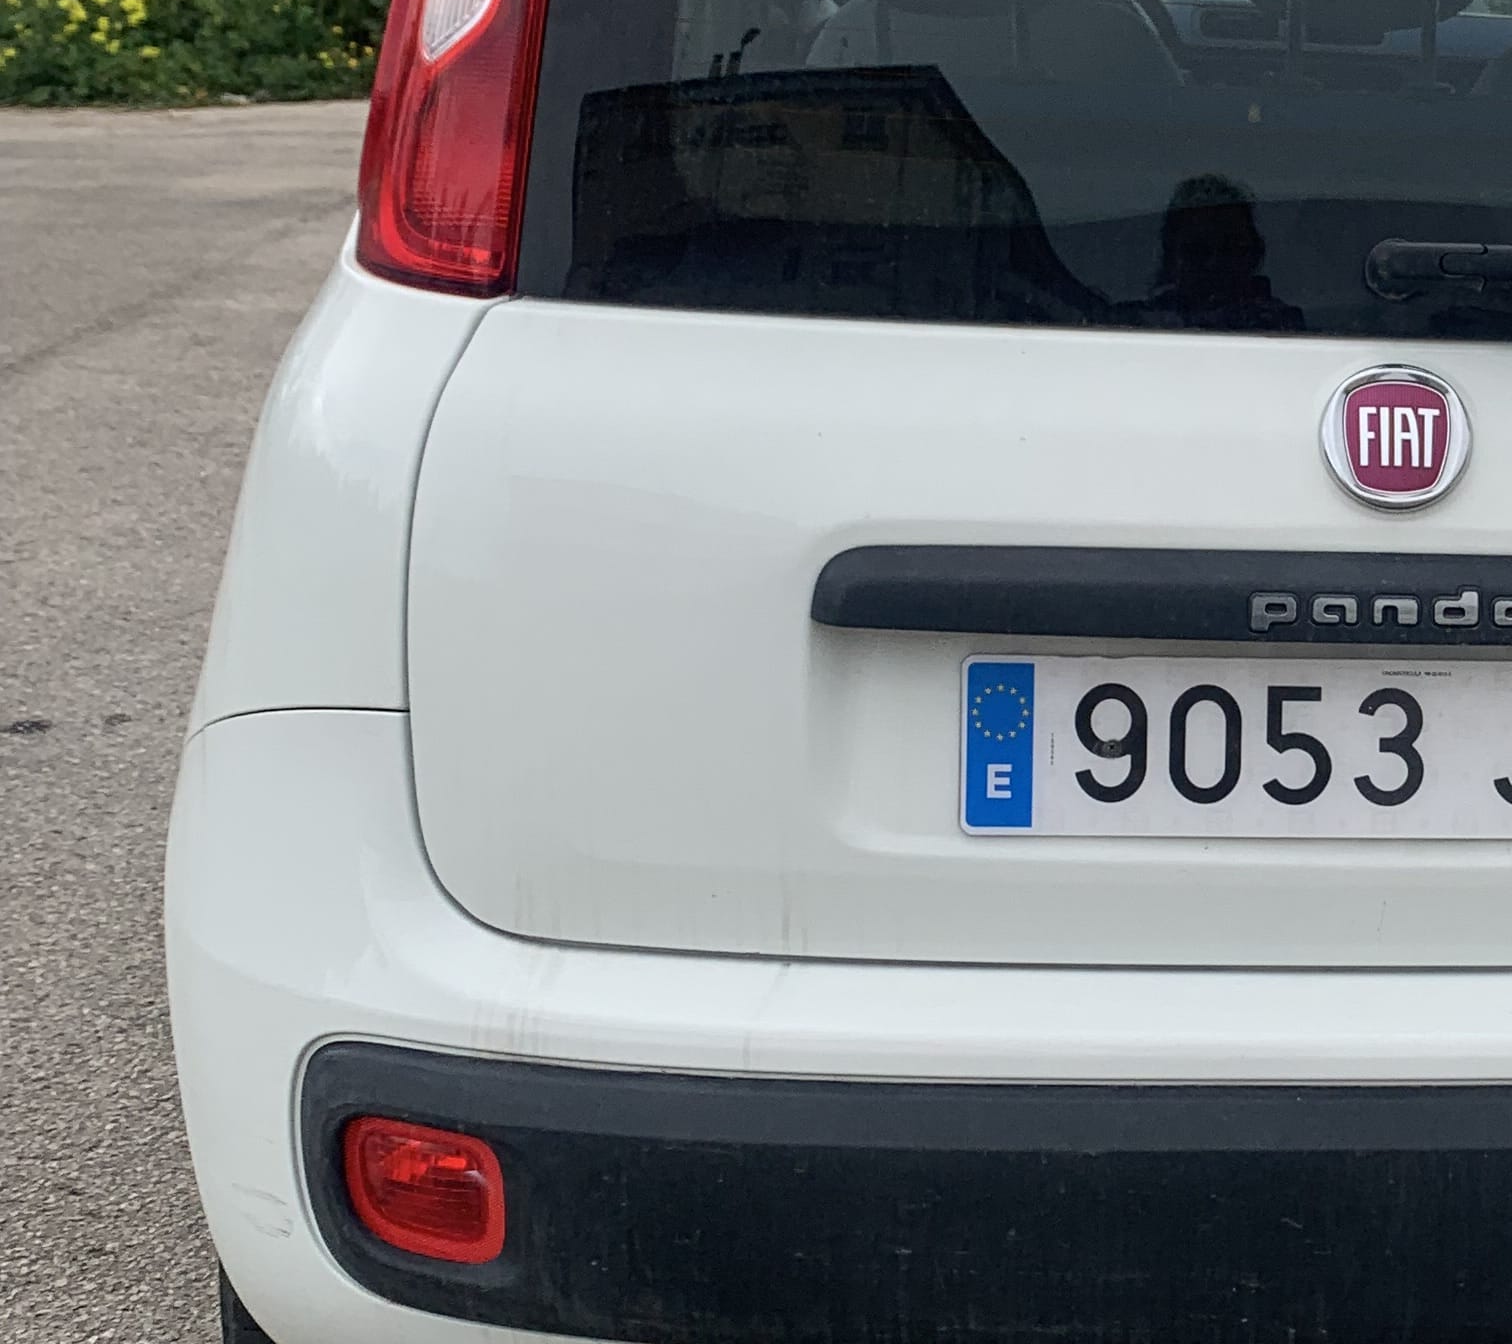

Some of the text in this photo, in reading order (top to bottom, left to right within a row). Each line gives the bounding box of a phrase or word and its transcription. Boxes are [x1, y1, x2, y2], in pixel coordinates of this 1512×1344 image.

[1359, 406, 1440, 468] FIAT
[1074, 682, 1425, 805] 9053
[986, 763, 1012, 799] E
